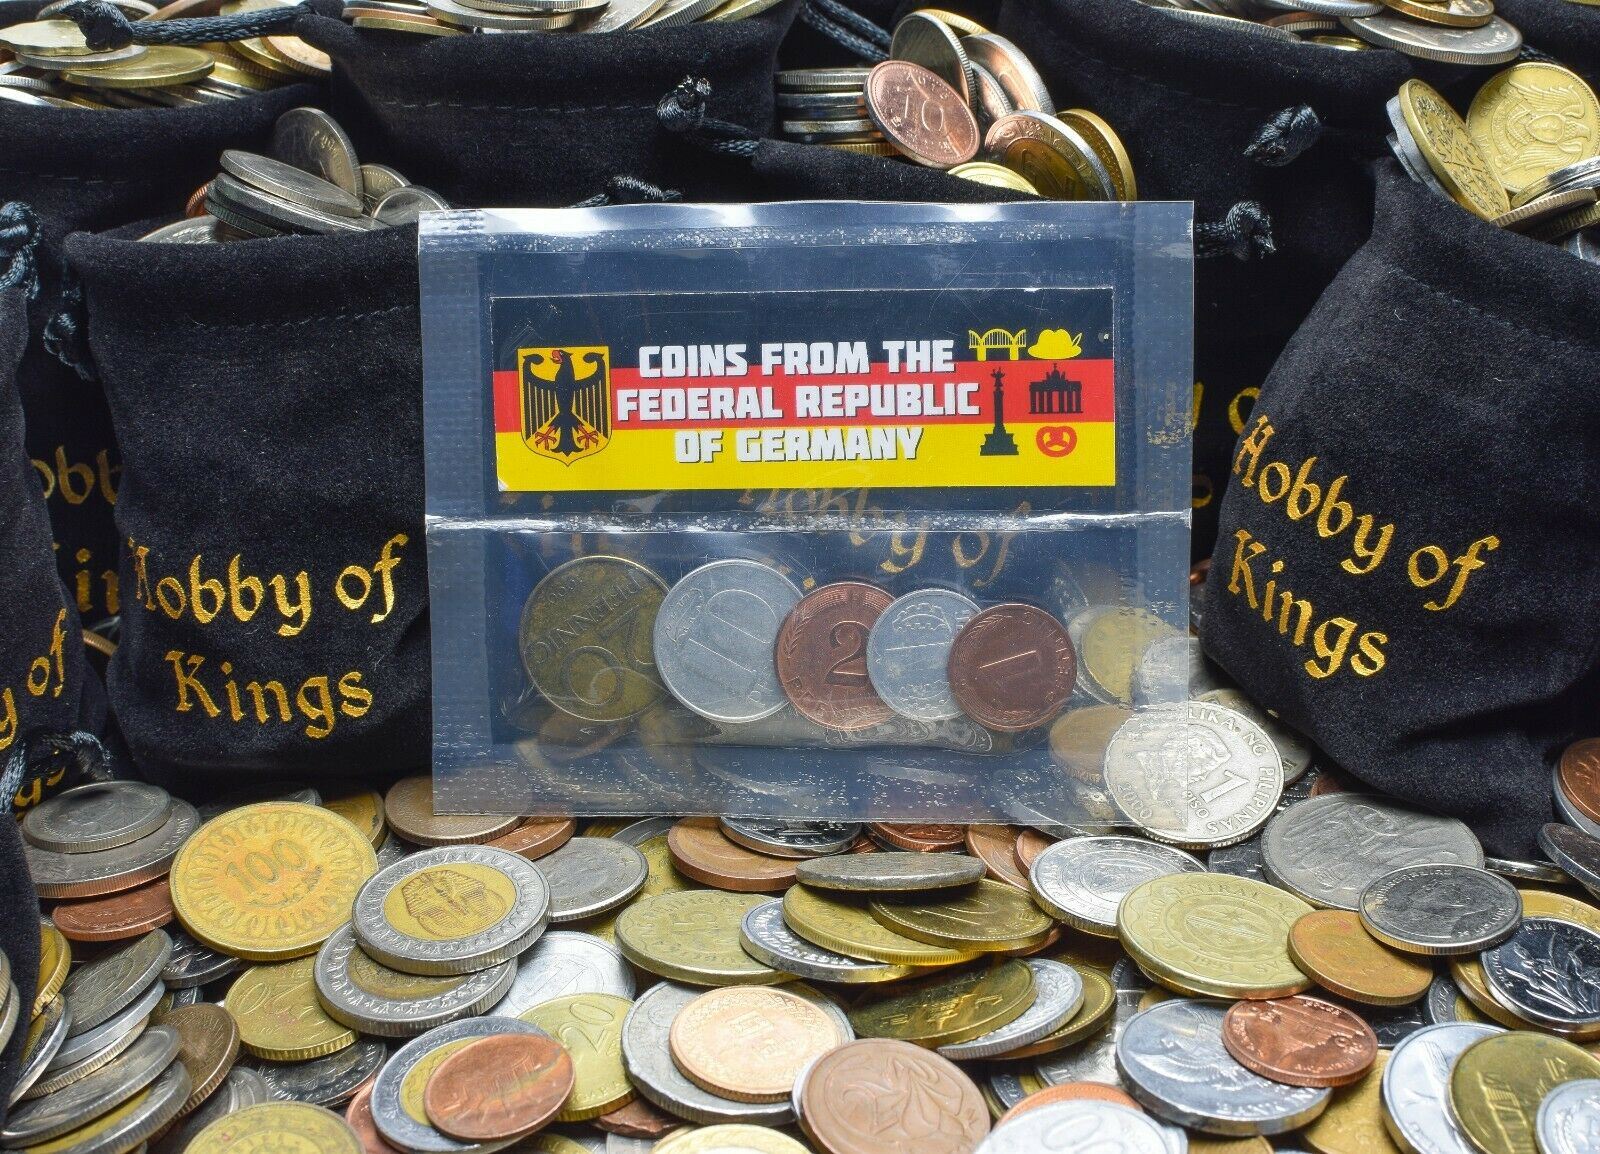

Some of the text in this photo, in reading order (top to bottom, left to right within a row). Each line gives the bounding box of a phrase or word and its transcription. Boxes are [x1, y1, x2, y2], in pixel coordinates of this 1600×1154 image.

[639, 340, 955, 378] COINS FROM THE
[617, 383, 981, 421] FEDERAL REPUBLIC
[675, 427, 924, 463] OF GERMANY
[1233, 414, 1500, 612] Hobby of
[335, 533, 408, 624] of
[1228, 529, 1389, 679] Kings
[27, 608, 67, 698] of
[829, 620, 870, 687] 2
[164, 649, 373, 739] Kings
[1243, 731, 1269, 757] NG
[1199, 769, 1250, 804] 1
[1206, 767, 1275, 834] PILIPINAS
[227, 838, 308, 892] 100
